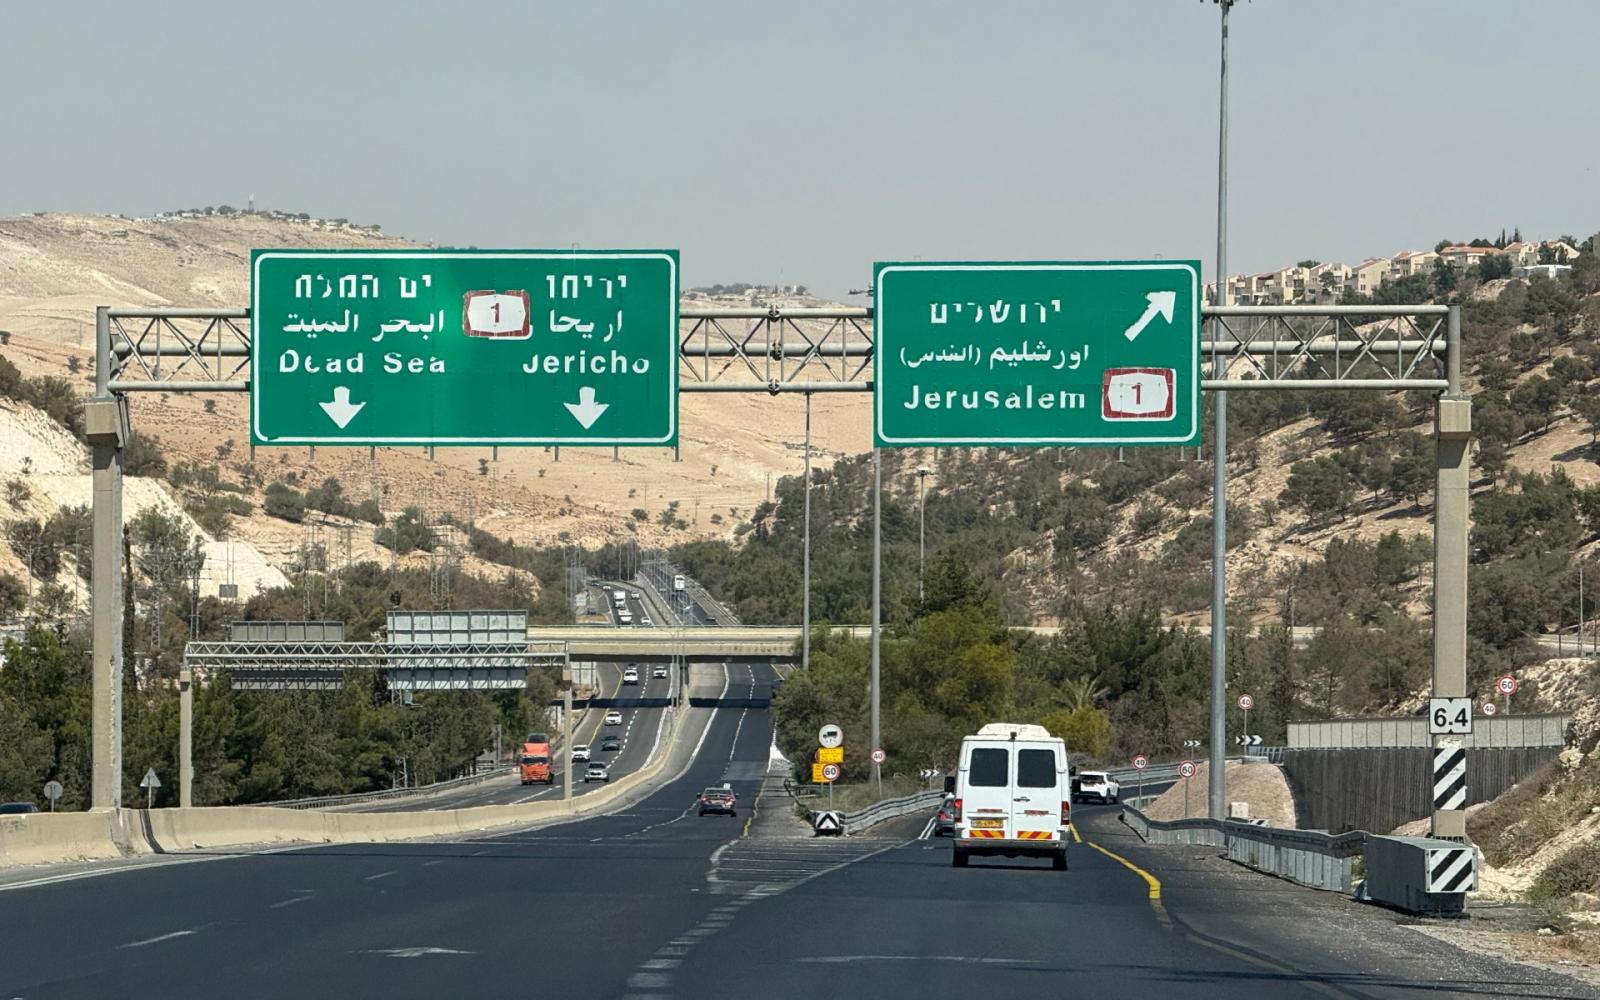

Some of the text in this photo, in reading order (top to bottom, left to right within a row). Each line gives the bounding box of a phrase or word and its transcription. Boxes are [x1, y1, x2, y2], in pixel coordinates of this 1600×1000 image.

[295, 274, 432, 298] ים המלח
[546, 274, 627, 299] יריחו
[282, 308, 444, 342] البحر الميت
[490, 302, 500, 324] 1
[549, 309, 623, 343] اريحا
[279, 349, 445, 373] Dead Sea
[522, 349, 650, 374] Jericho
[989, 340, 1089, 370] اورشليم
[903, 384, 1085, 409] Jerusalem
[1130, 384, 1141, 405] 1
[1501, 681, 1513, 689] 60
[1241, 698, 1250, 706] 40
[1433, 707, 1468, 727] 6.4
[824, 767, 836, 775] 60
